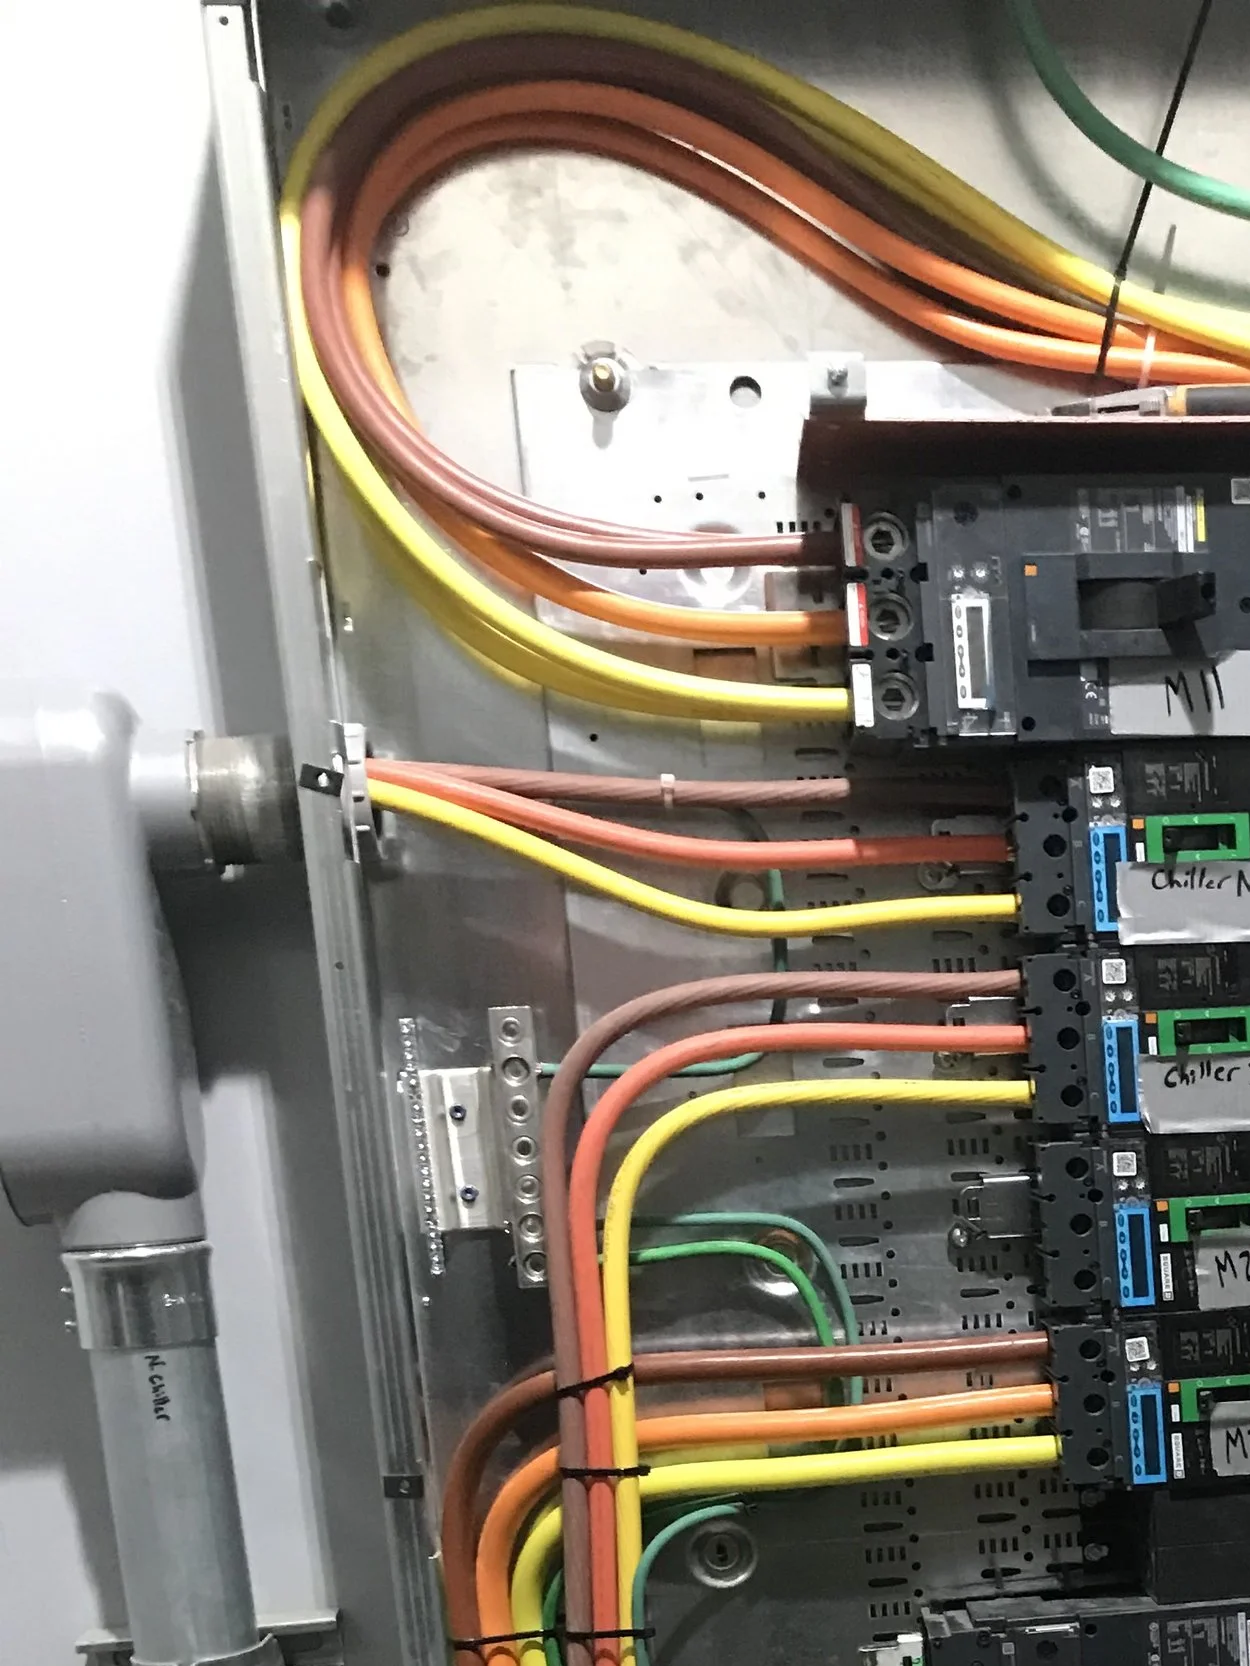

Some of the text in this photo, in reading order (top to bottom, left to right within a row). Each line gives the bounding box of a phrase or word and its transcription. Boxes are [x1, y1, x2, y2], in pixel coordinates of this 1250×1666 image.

[1164, 664, 1224, 717] M11
[1151, 866, 1232, 892] Chiller
[1164, 1062, 1241, 1089] Chiller
